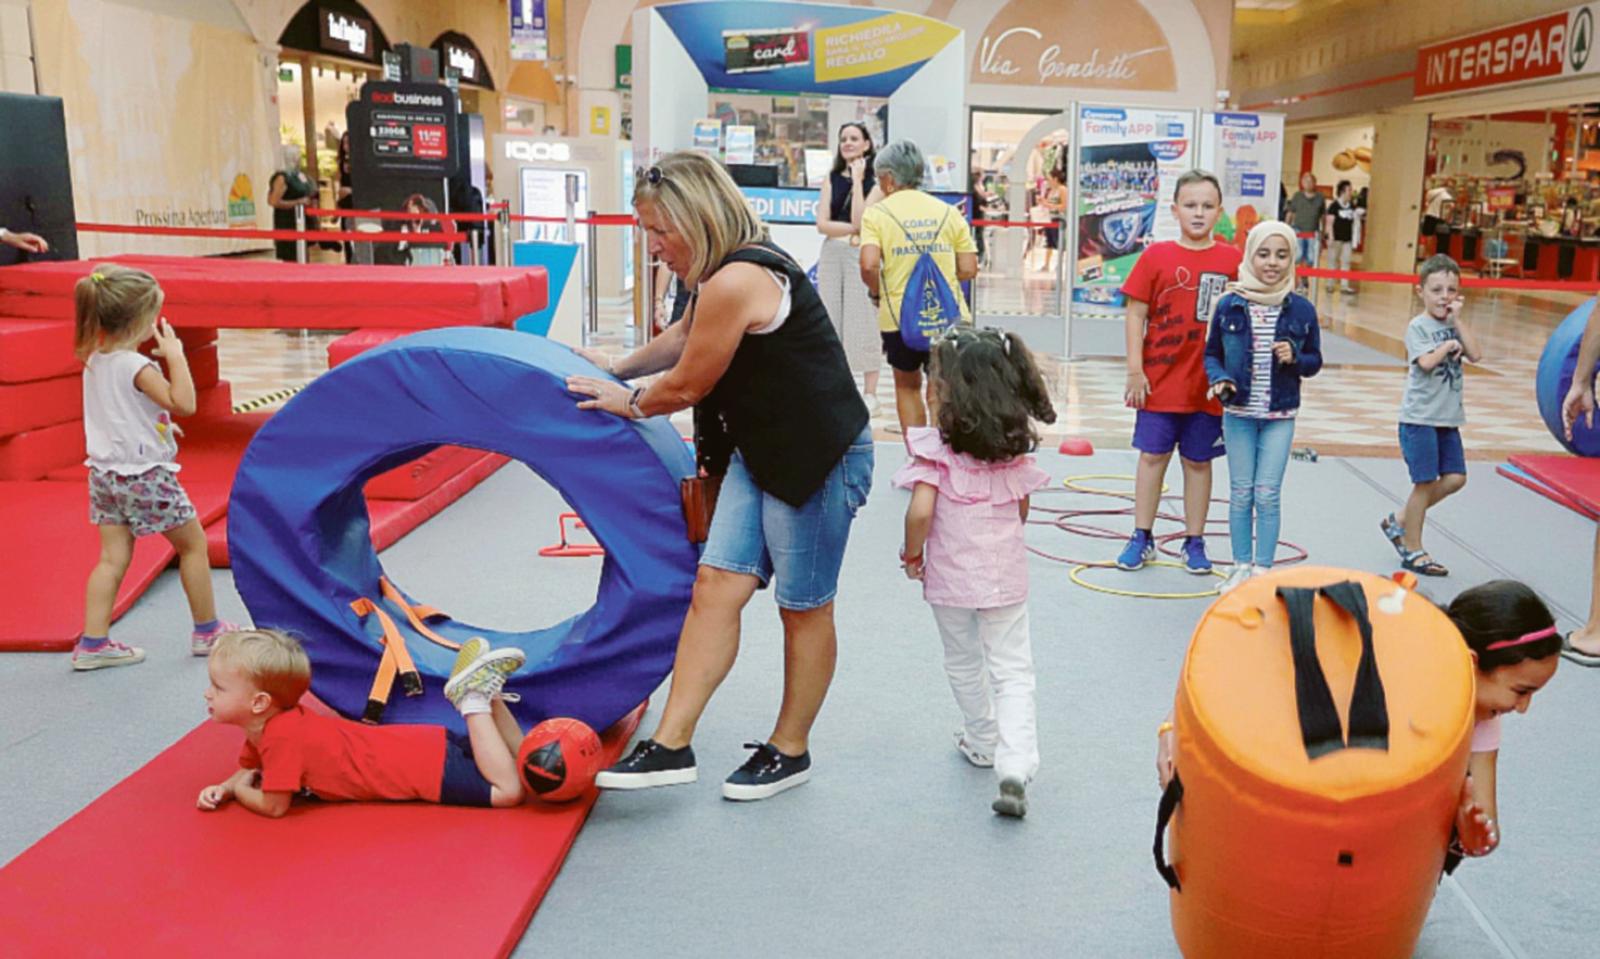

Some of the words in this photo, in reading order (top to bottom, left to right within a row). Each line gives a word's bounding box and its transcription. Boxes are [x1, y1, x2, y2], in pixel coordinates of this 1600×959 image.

[753, 36, 796, 59] card
[980, 27, 1042, 74] Via
[1426, 24, 1565, 86] INTERSPAR
[825, 48, 886, 68] REGALO
[1085, 122, 1127, 137] Family
[1128, 123, 1153, 134] APP
[1222, 129, 1255, 143] Family
[1256, 131, 1277, 141] APP
[505, 141, 570, 161] IQOS
[902, 220, 937, 229] COACH
